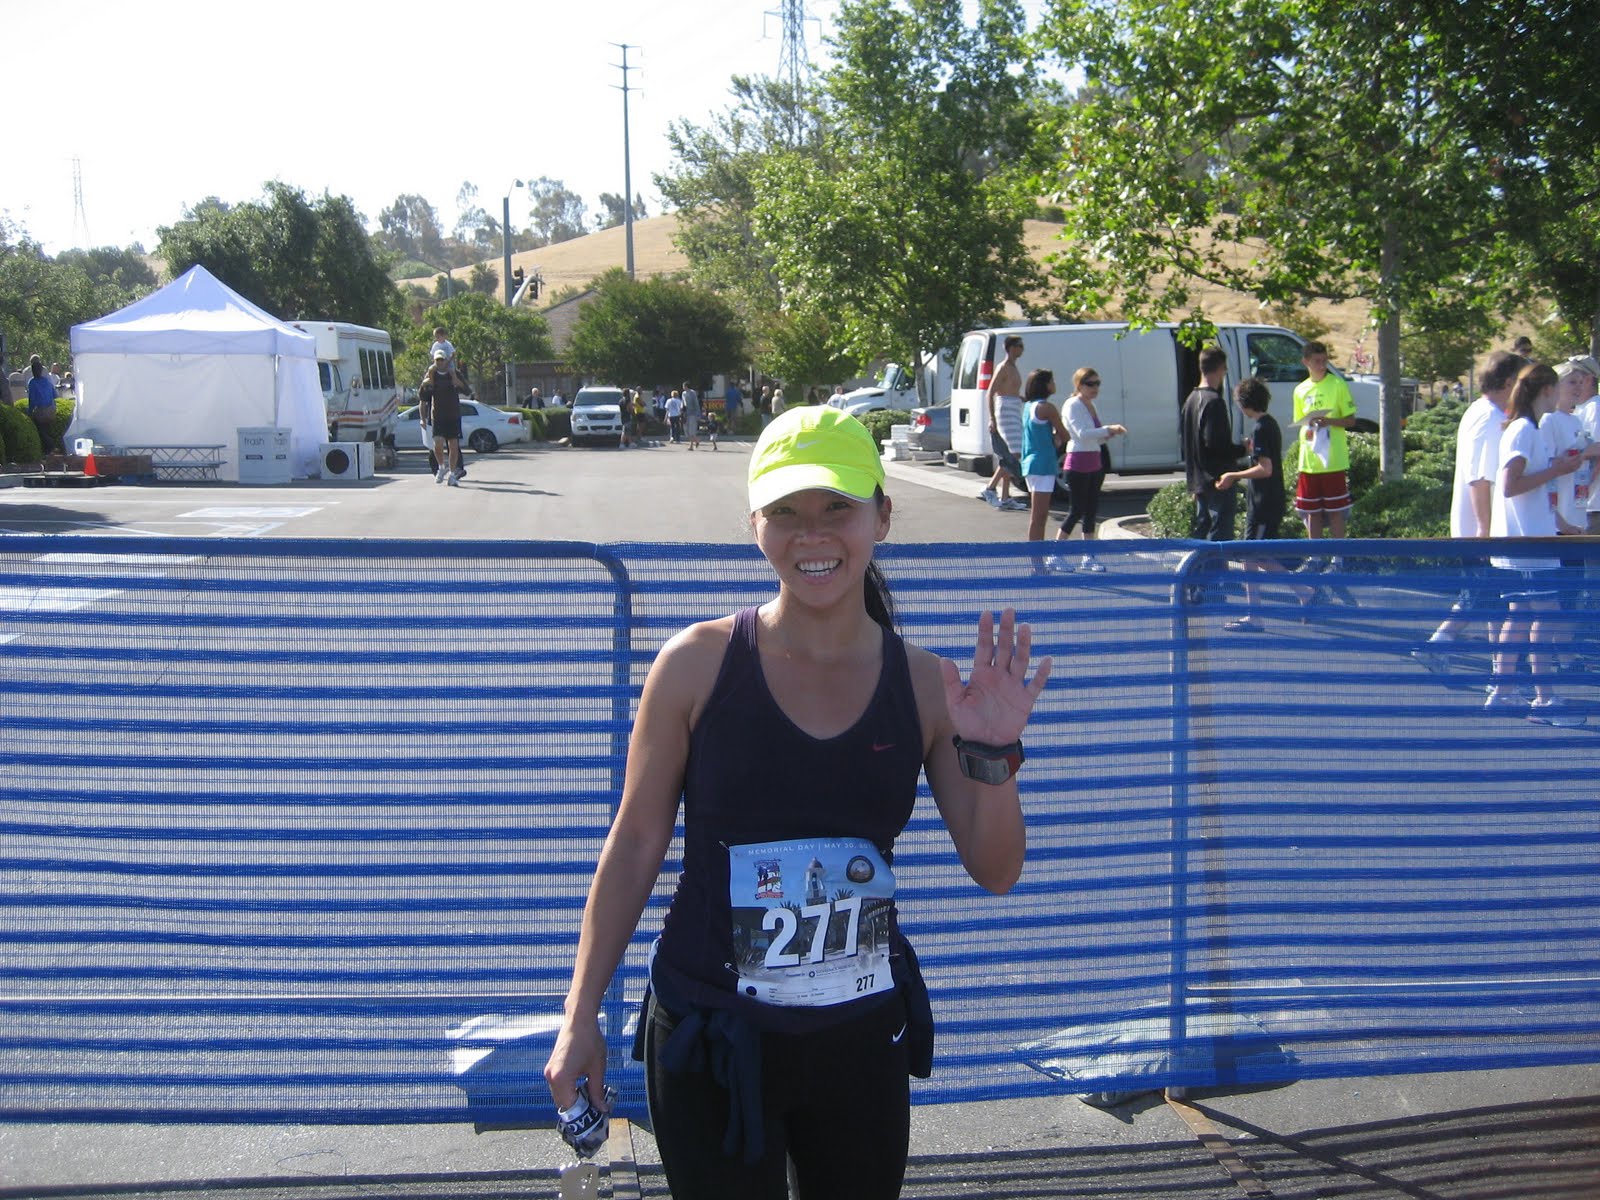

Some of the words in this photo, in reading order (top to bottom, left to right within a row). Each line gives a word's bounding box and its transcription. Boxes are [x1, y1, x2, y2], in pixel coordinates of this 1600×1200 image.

[244, 436, 265, 446] trash
[748, 845, 794, 856] MEMORIAL
[797, 843, 815, 851] DAY
[824, 842, 841, 850] MAY
[762, 897, 862, 968] 277
[856, 973, 875, 993] 277
